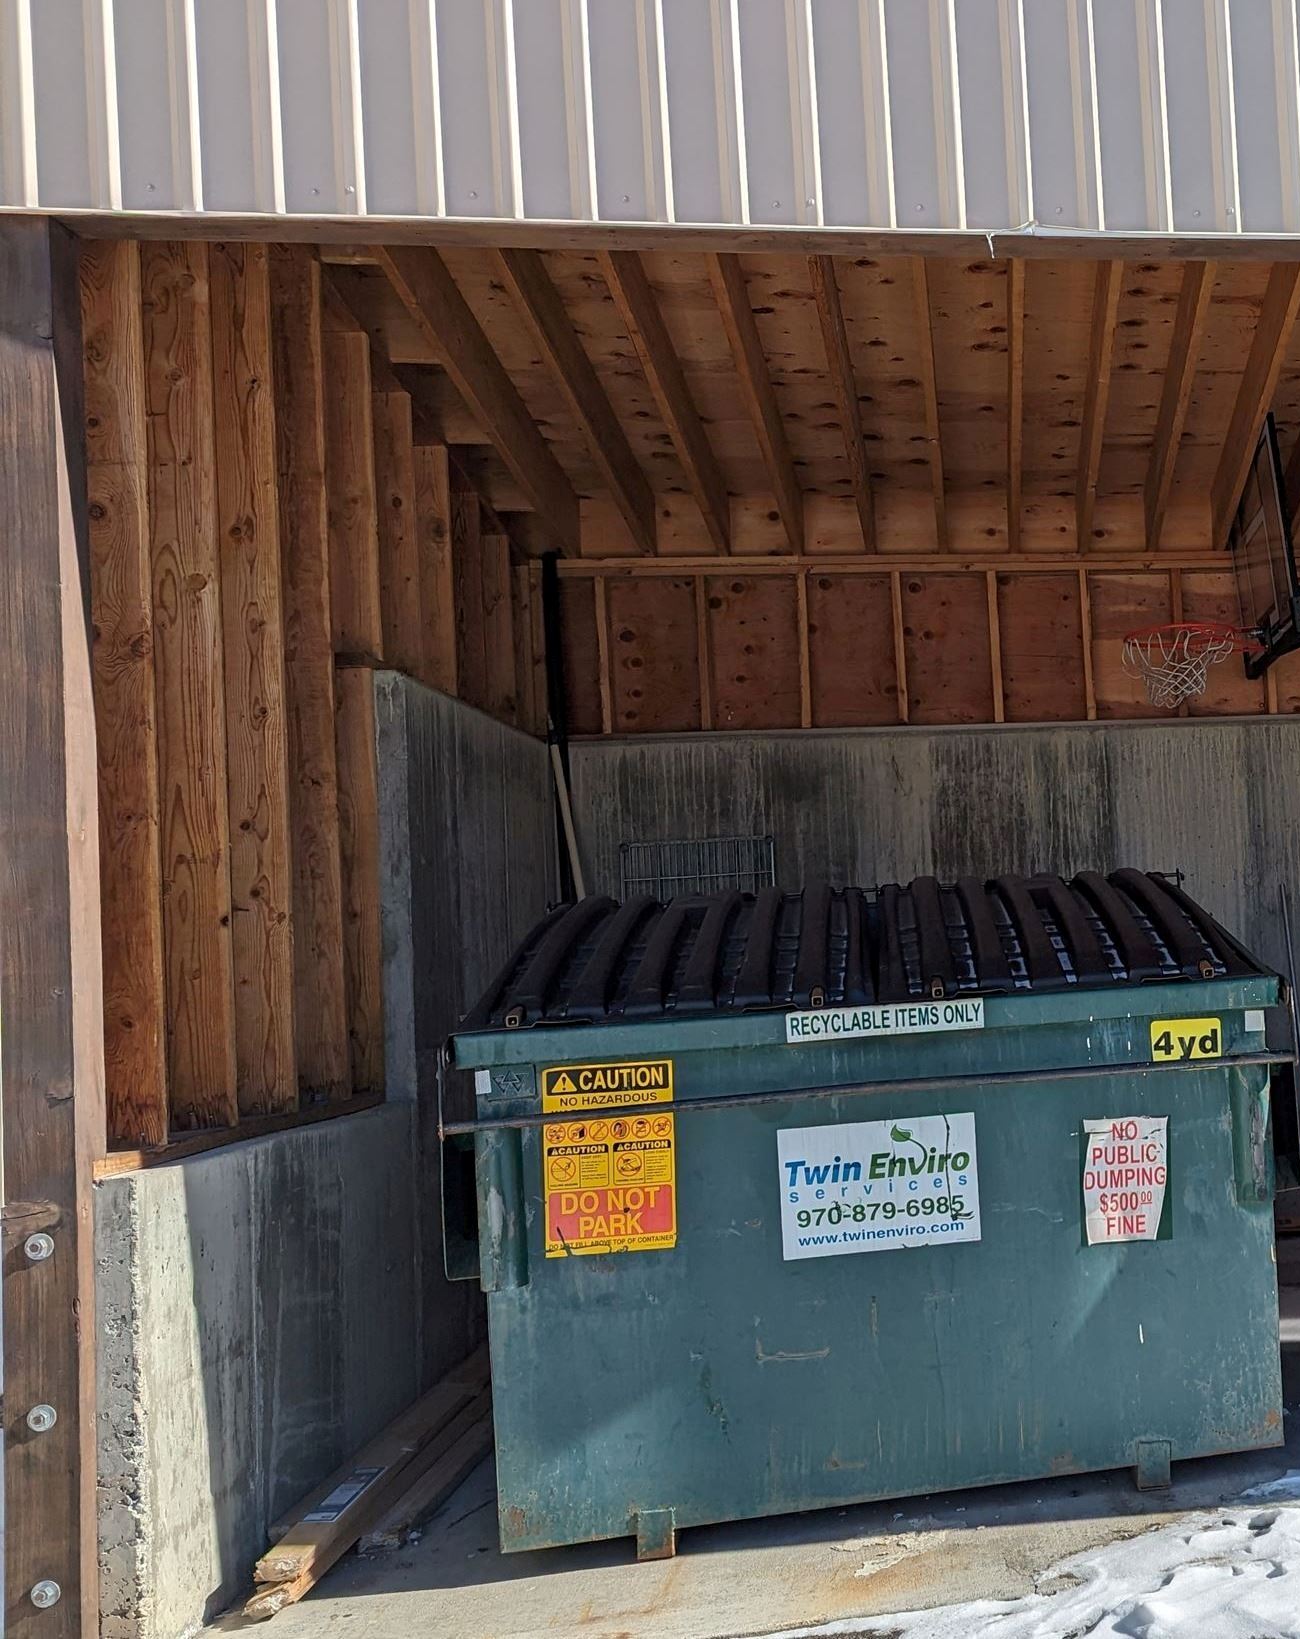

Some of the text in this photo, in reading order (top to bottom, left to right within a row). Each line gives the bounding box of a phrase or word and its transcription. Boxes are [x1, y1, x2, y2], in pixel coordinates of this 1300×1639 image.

[790, 1003, 981, 1036] RECYCLABLE ITEMS ONLY
[1154, 1028, 1218, 1061] 4yd
[579, 1066, 663, 1091] CAUTION
[560, 1092, 658, 1107] NO HAZARDOUS
[1111, 1120, 1138, 1141] NO
[558, 1145, 605, 1155] CAUTION
[624, 1140, 668, 1150] CAUTION
[1093, 1143, 1157, 1166] PUBLIC
[785, 1147, 970, 1187] Twin Enviro
[1085, 1167, 1166, 1190] DUMPING
[561, 1186, 660, 1215] DO NOT
[796, 1195, 965, 1228] 970-879-6985
[579, 1212, 644, 1238] PARK
[798, 1222, 965, 1246] www.twinenviro.com
[1107, 1214, 1146, 1235] FINE
[637, 1235, 673, 1243] CONTAINER
